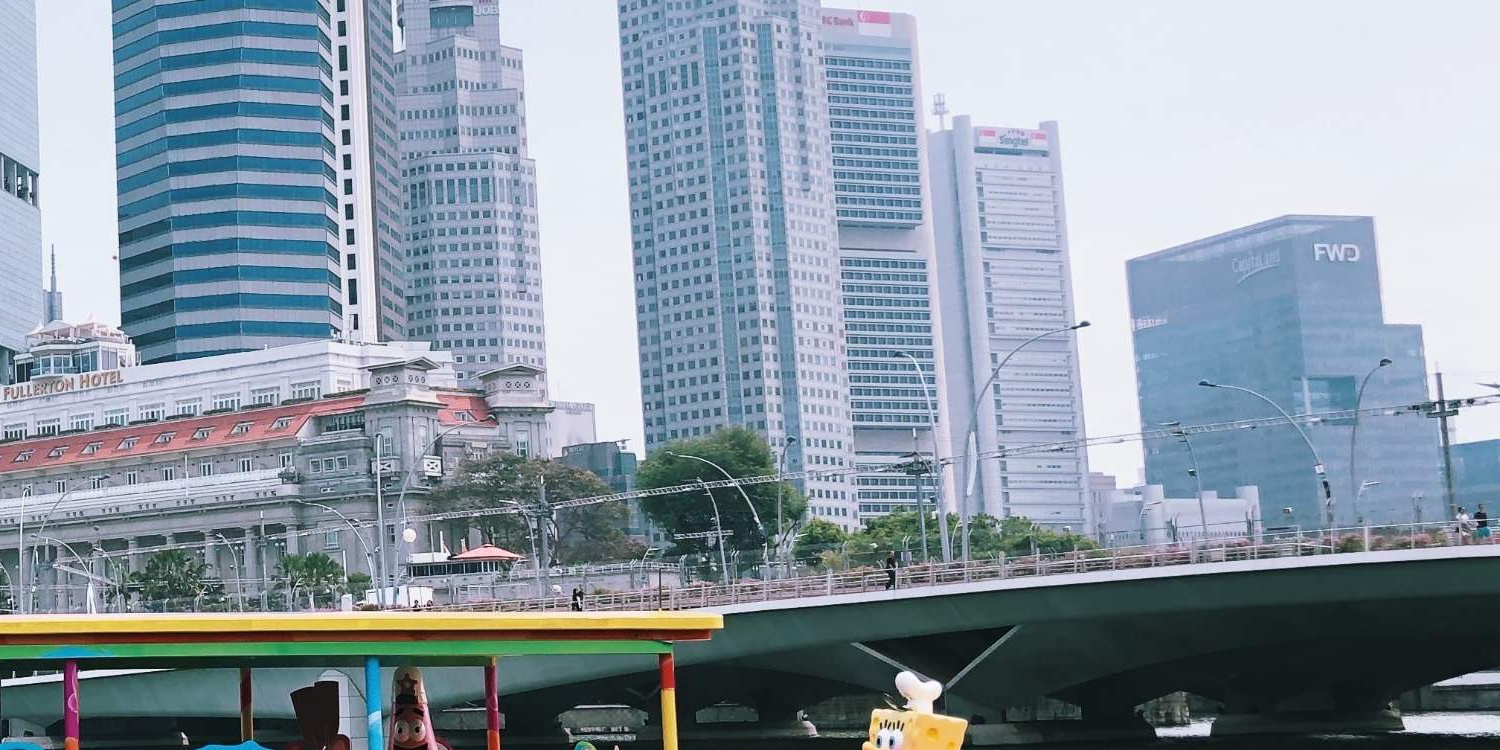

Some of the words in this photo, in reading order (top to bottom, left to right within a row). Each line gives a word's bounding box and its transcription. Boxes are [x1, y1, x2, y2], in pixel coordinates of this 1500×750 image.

[1313, 243, 1360, 262] FWD
[3, 378, 74, 401] FULLERTON
[79, 370, 124, 389] HOTEL
